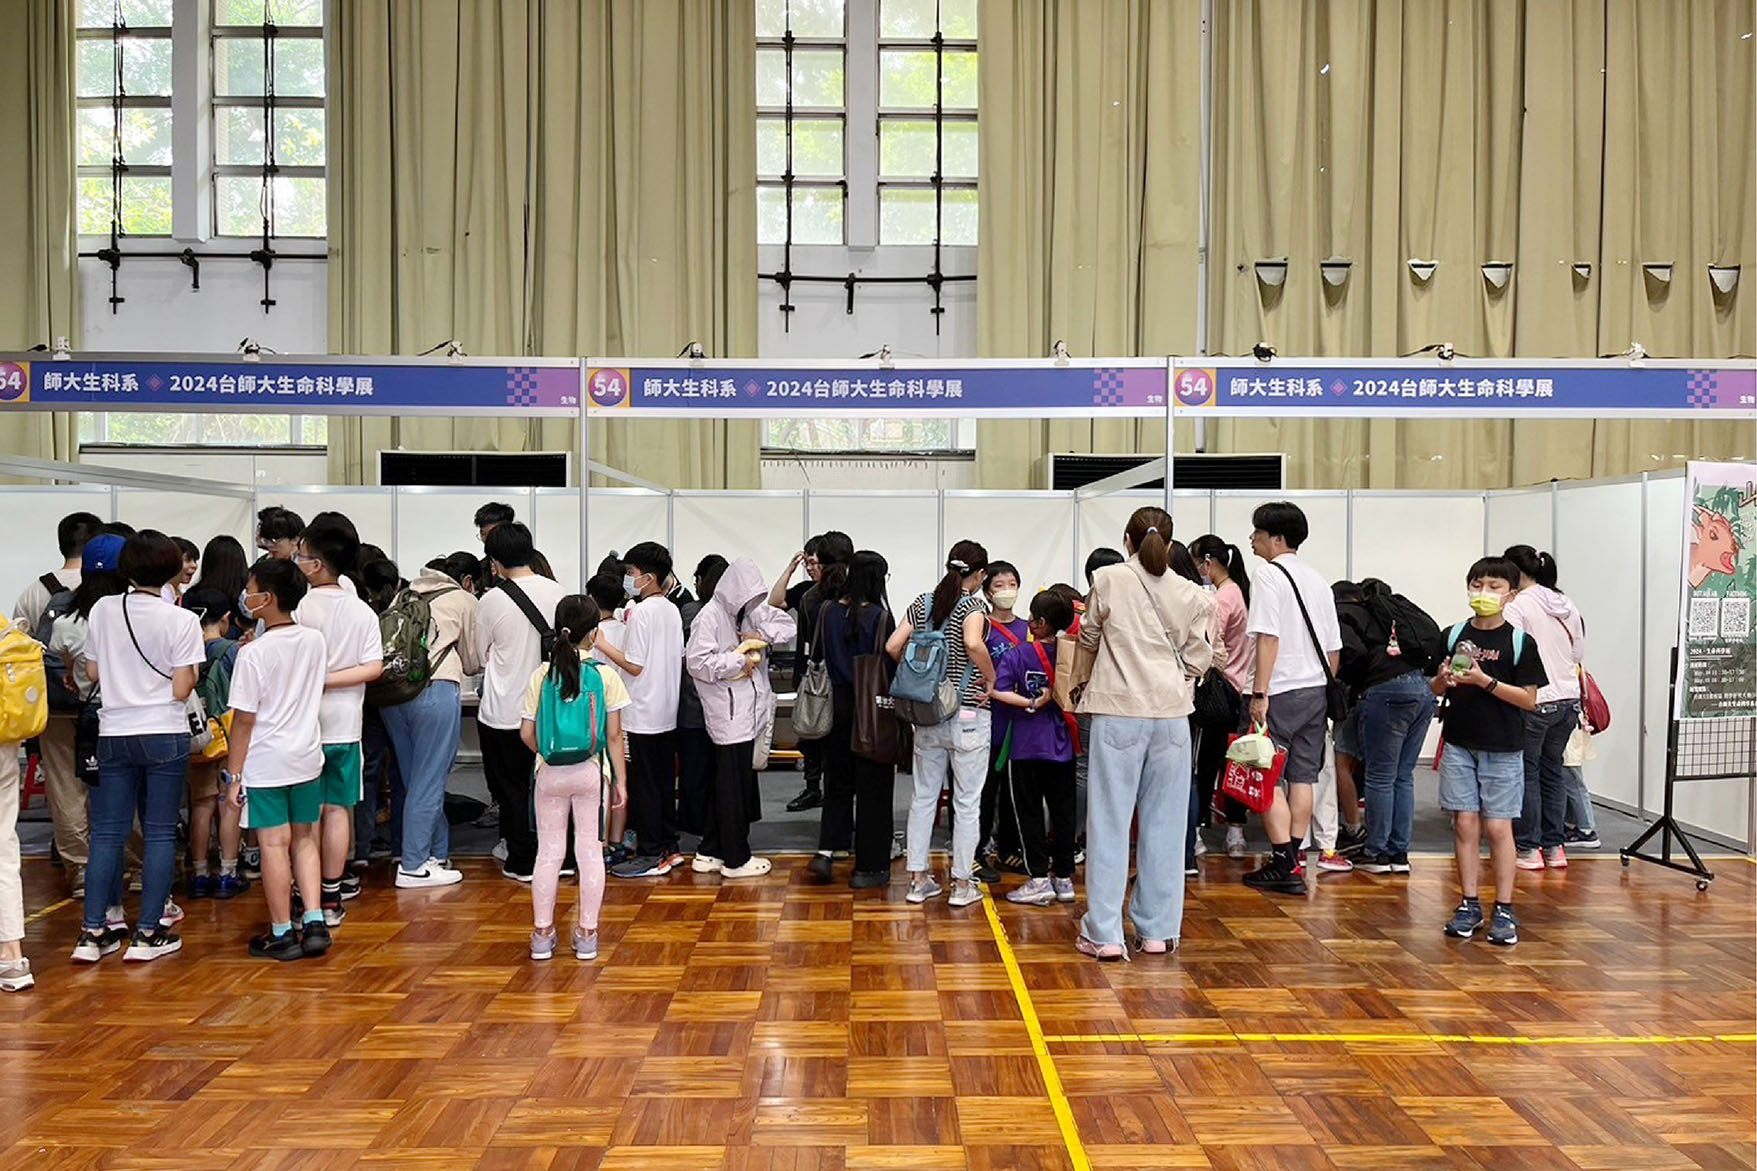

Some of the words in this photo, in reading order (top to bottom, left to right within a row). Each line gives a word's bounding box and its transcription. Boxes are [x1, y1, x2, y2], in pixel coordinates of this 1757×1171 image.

[44, 372, 139, 392] 師大生科系
[170, 375, 374, 395] 2024台師大生命科學展
[594, 378, 621, 396] 54
[644, 378, 737, 397] 師大生科系
[767, 379, 963, 398] 2024台師大生命科學展
[1180, 378, 1208, 396] 54
[1230, 378, 1323, 397] 師大生科系
[1353, 378, 1554, 397] 2024台師大生命科學展
